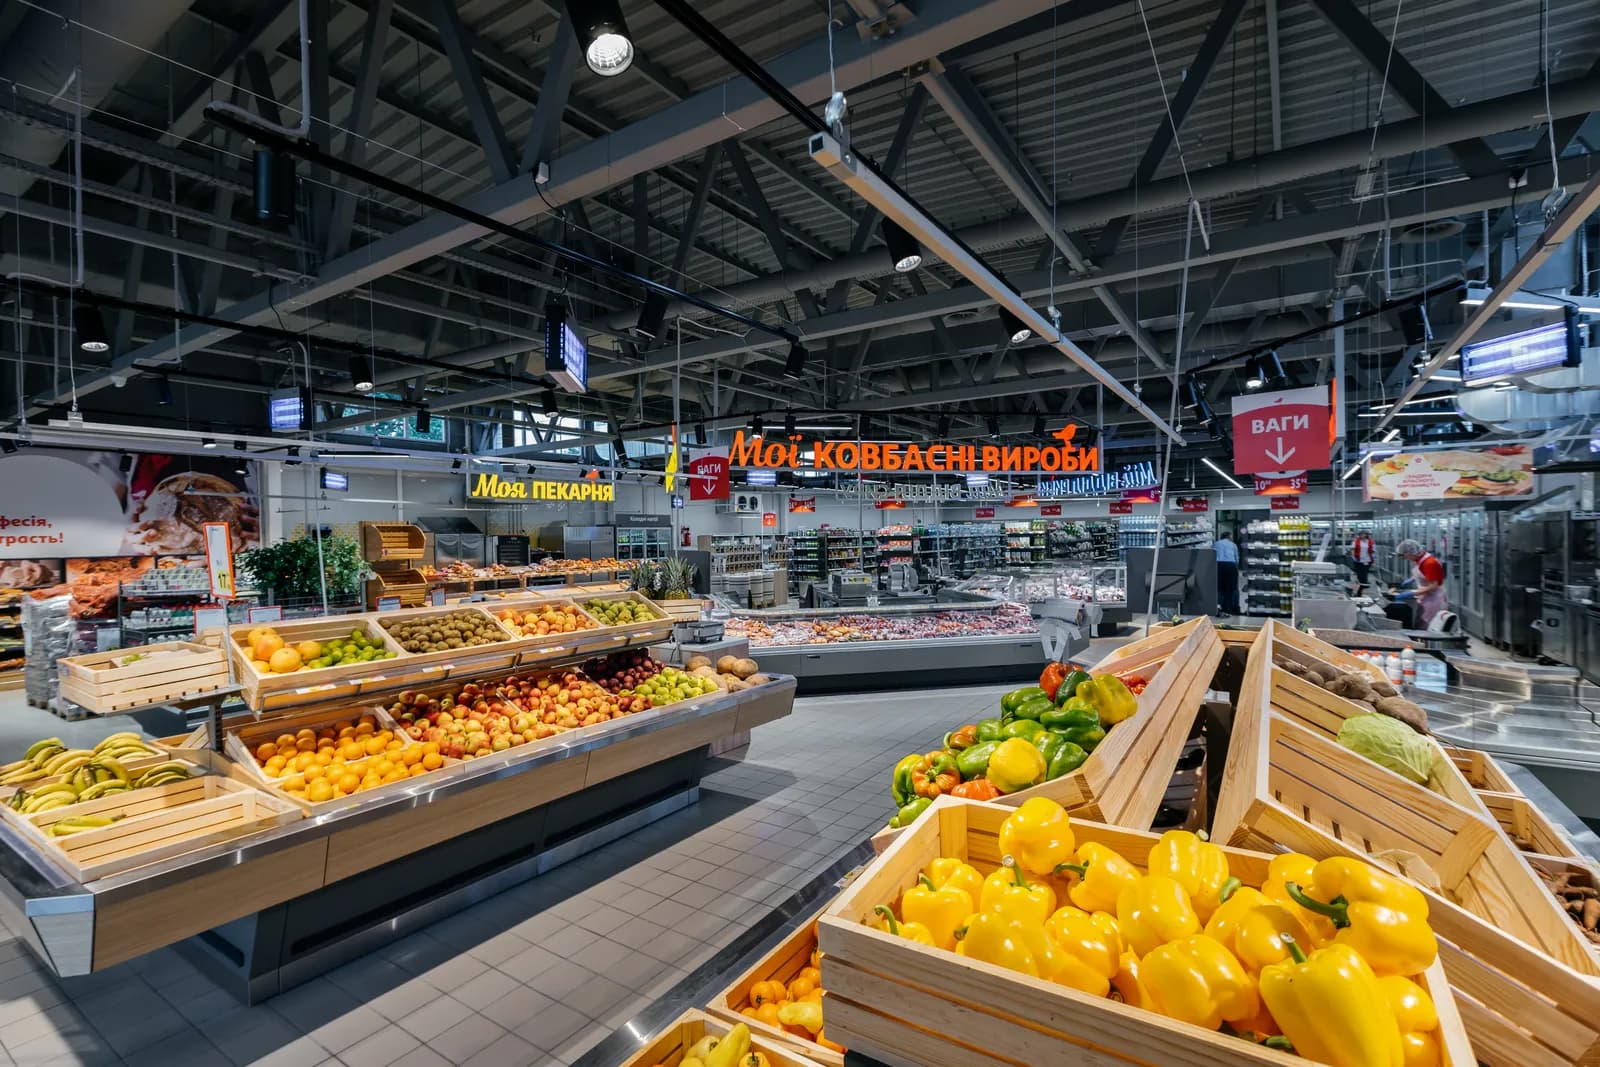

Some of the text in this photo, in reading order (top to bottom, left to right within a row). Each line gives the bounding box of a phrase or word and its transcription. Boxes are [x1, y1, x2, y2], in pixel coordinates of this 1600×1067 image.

[1251, 414, 1309, 434] ВАГИ
[729, 430, 1099, 472] Мої КОВБАСНІ ВИРОБИ
[697, 463, 721, 475] ВАГИ
[472, 473, 614, 502] Моя ПЕКАРНЯ
[0, 515, 52, 530] фесія,
[218, 573, 226, 589] 17
